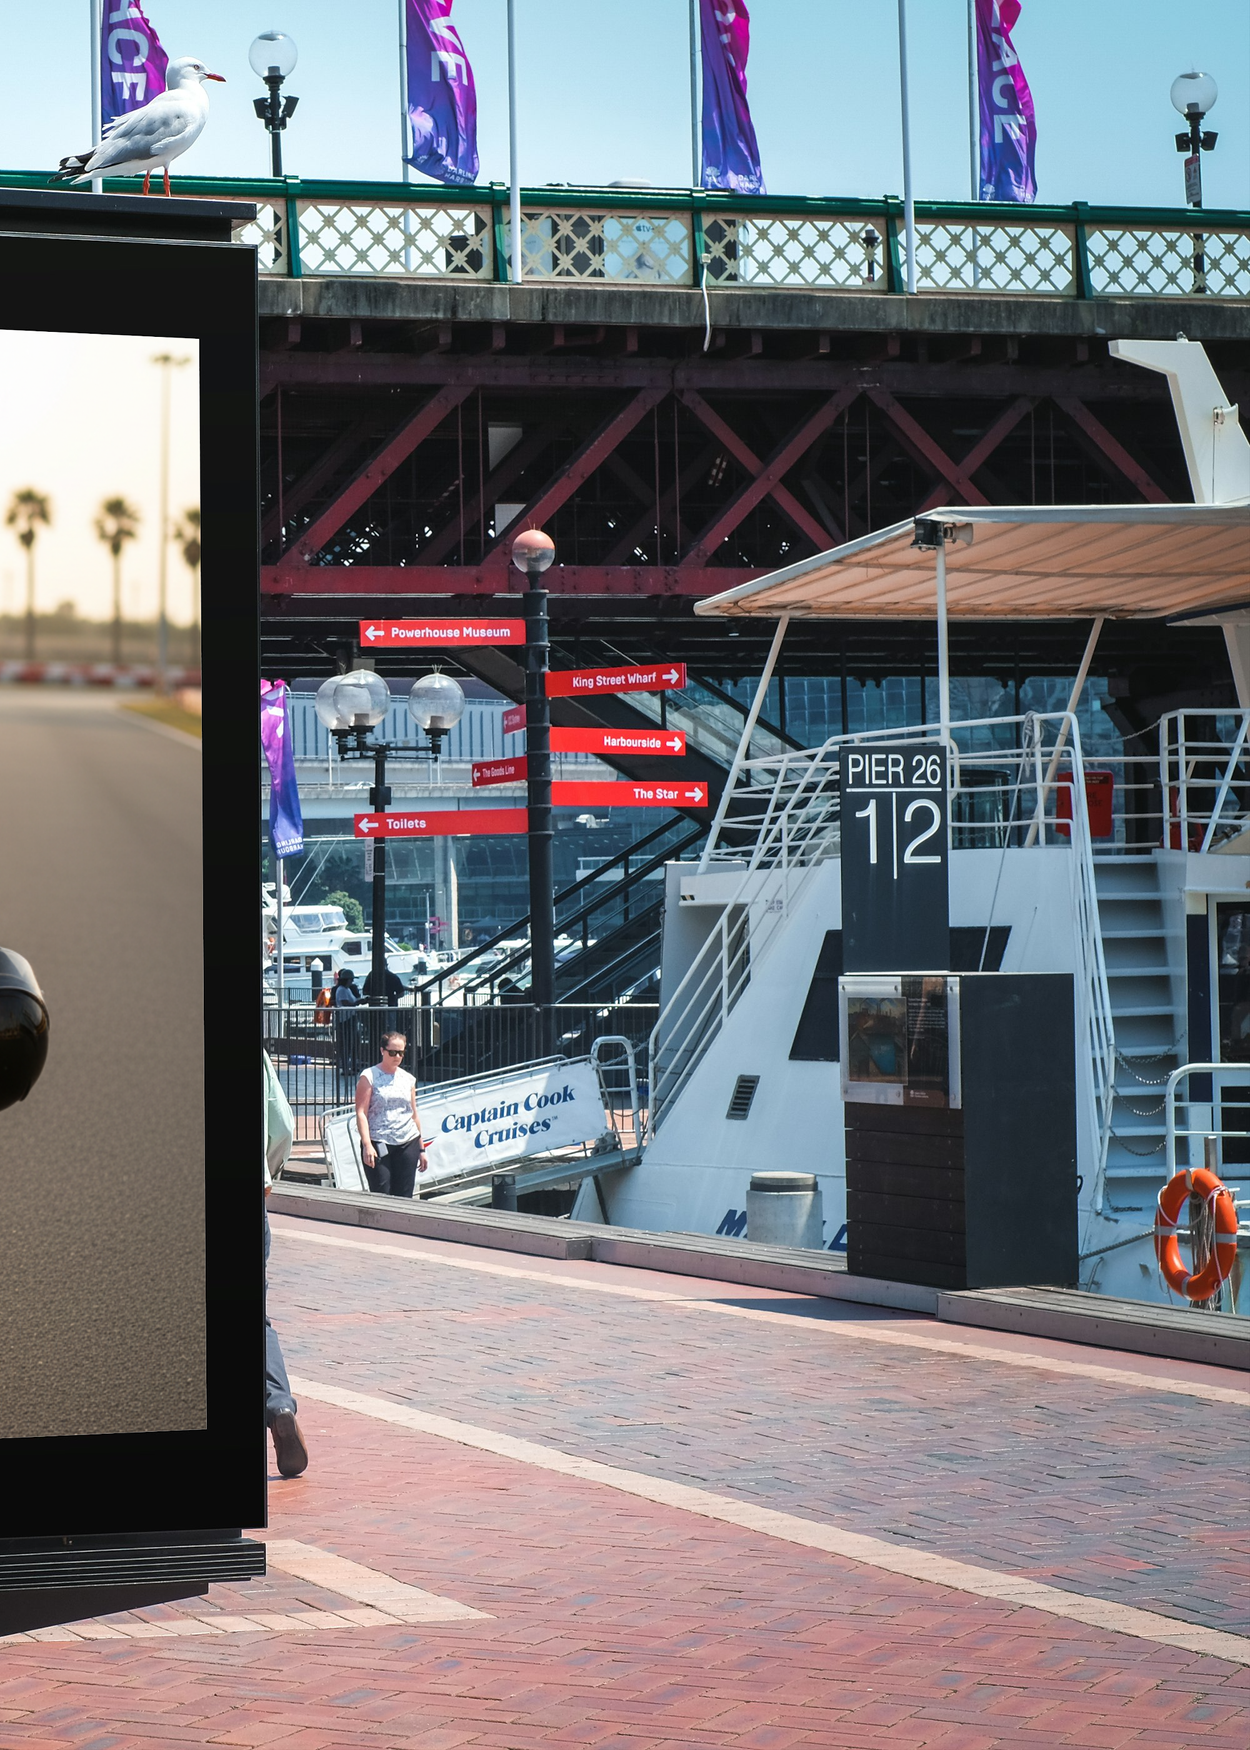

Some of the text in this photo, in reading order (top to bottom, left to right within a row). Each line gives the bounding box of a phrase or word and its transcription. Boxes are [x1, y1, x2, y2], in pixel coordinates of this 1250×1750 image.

[391, 626, 511, 638] Powerhouse Museum
[572, 672, 657, 689] King Street Wharf
[603, 736, 661, 748] Harbourside
[482, 764, 515, 778] The Goods Line
[848, 754, 941, 785] PIER 26
[633, 788, 679, 799] The Star
[386, 818, 427, 830] Toilets
[855, 798, 942, 864] 1 2
[441, 1085, 576, 1133] Captain Cook
